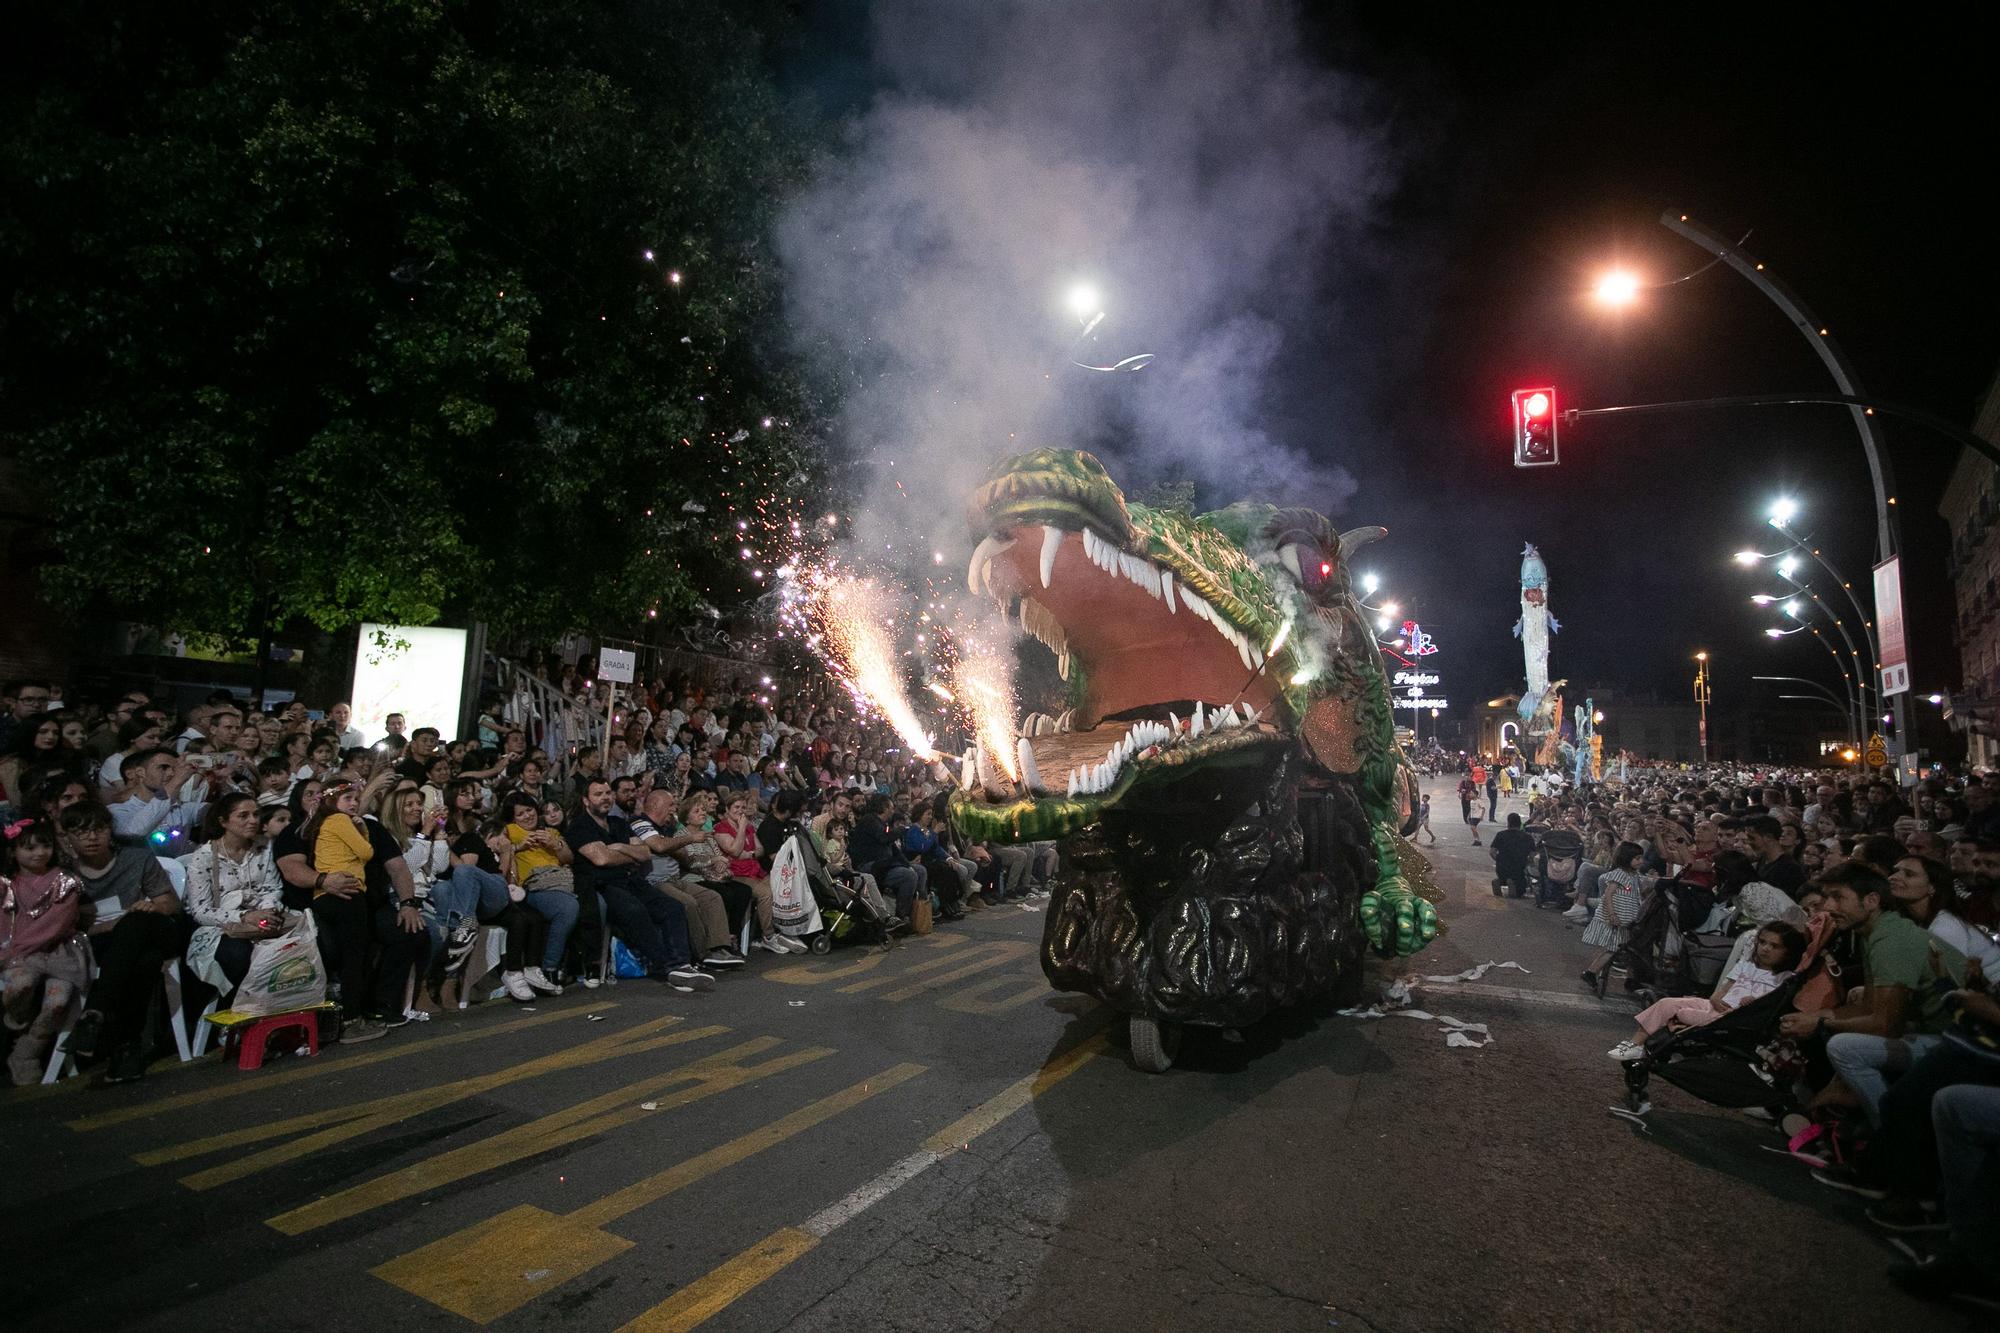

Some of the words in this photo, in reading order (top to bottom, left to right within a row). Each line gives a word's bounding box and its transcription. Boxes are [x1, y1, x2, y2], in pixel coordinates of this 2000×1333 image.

[604, 660, 625, 669] GRADA
[1393, 672, 1439, 684] Fiestas
[1407, 686, 1424, 696] de
[1869, 754, 1884, 762] 20
